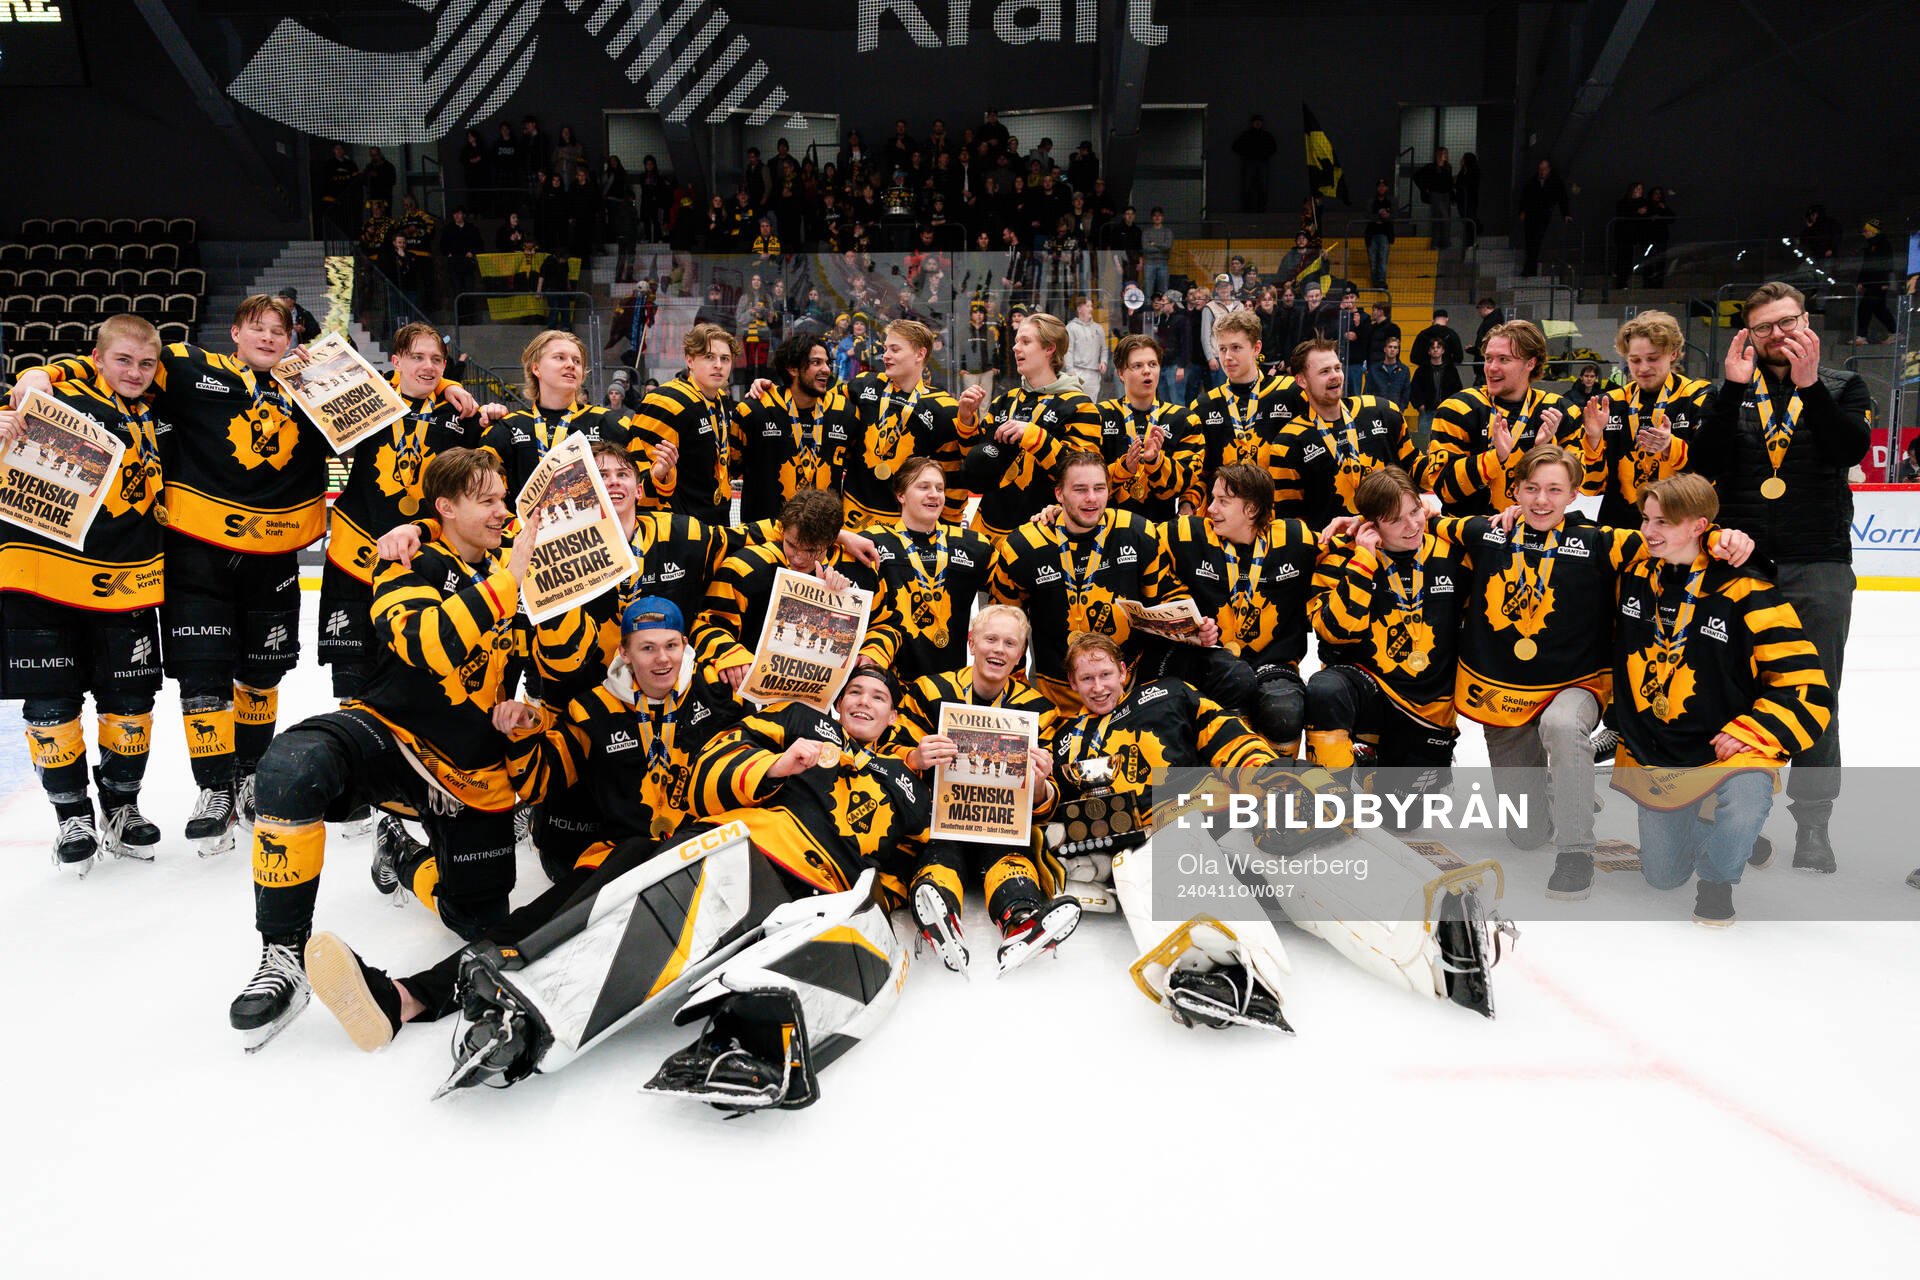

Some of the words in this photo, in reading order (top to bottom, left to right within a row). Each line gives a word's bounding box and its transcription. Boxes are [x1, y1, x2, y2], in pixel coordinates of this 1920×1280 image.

[203, 375, 223, 385] ICA
[197, 383, 229, 393] KVANTUM
[864, 386, 876, 395] ICA
[321, 382, 376, 417] SVENSKA
[332, 394, 387, 433] MÄSTARE
[1274, 404, 1288, 412] ICA
[31, 399, 100, 440] NORRAN
[1209, 411, 1221, 419] ICA
[766, 422, 777, 430] ICA
[832, 424, 844, 433] ICA
[1303, 443, 1319, 455] ICA
[833, 445, 846, 466] C
[8, 468, 79, 510] SVENSKA
[0, 487, 74, 528] MÄSTARE
[266, 520, 300, 529] Skellefteå
[531, 525, 604, 569] SVENSKA
[1566, 537, 1585, 549] ICA
[954, 548, 968, 559] ICA
[1120, 546, 1136, 556] ICA
[1559, 547, 1589, 557] KVANTUM
[534, 546, 614, 594] MÄSTARE
[664, 562, 680, 573] ICA
[1037, 565, 1055, 576] ICA
[1202, 560, 1214, 573] ICA
[1280, 563, 1294, 574] ICA
[137, 578, 161, 589] Kraft
[1435, 576, 1453, 585] ICA
[783, 579, 845, 608] NORRAN
[1708, 617, 1726, 632] ICA
[172, 626, 231, 637] HOLMEN
[9, 657, 74, 669] HOLMEN
[771, 654, 832, 683] SVENSKA
[760, 672, 827, 694] MÄSTARE
[1141, 686, 1160, 697] ICA
[1501, 703, 1523, 712] Kraft
[949, 712, 1013, 729] NORRAN
[820, 719, 836, 735] ICA
[611, 731, 630, 743] ICA
[815, 726, 842, 745] KVANTUM
[607, 740, 638, 753] KVANTUM
[444, 773, 467, 790] Kraft
[901, 774, 913, 793] ICA
[951, 784, 1015, 805] SVENSKA
[949, 800, 1015, 824] MÄSTARE
[679, 824, 741, 861] CCM
[453, 846, 513, 863] MARTINSONS
